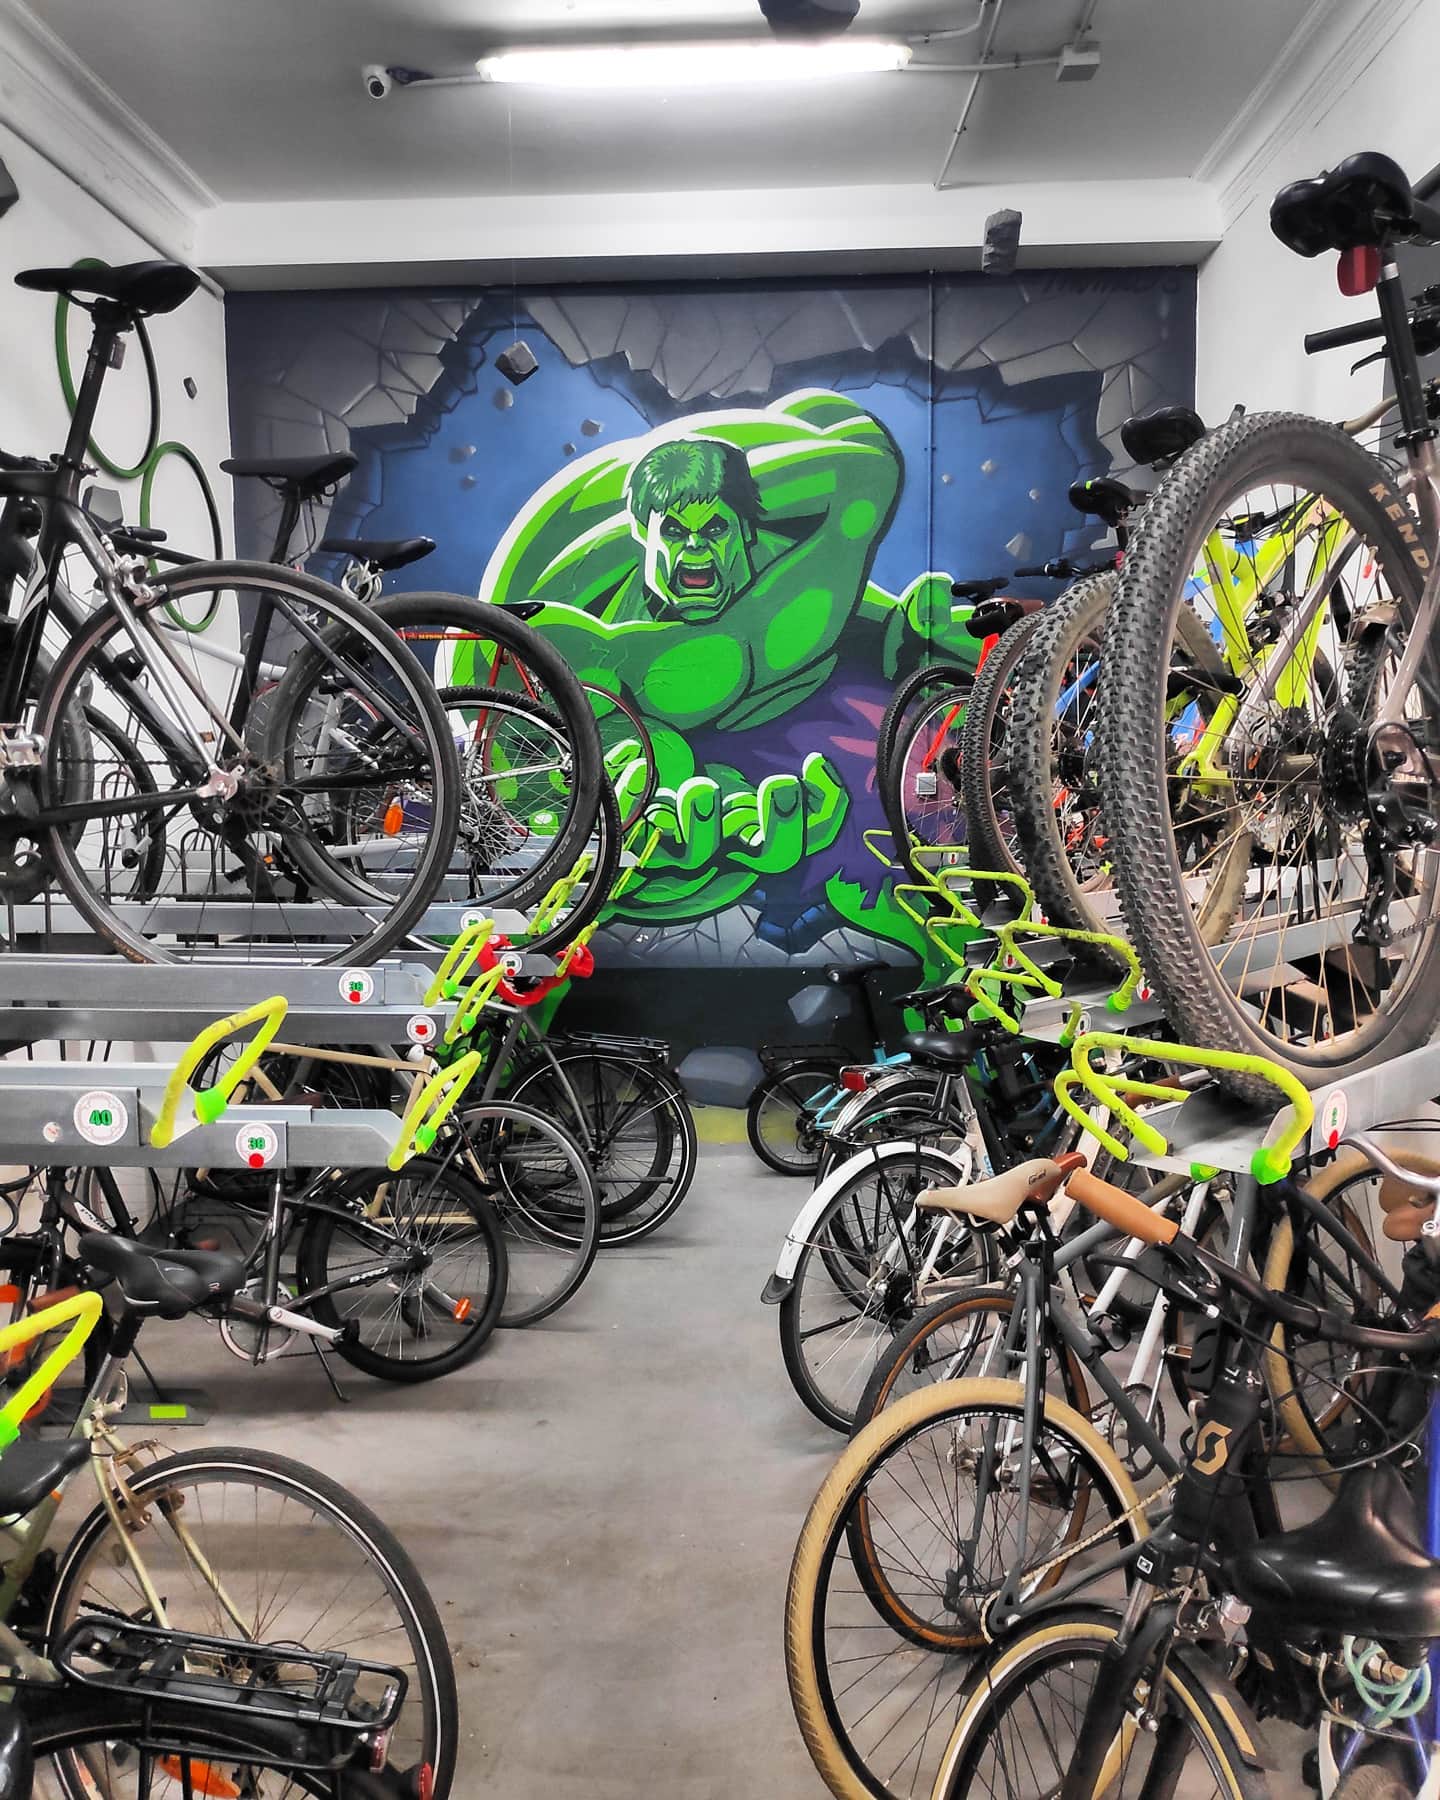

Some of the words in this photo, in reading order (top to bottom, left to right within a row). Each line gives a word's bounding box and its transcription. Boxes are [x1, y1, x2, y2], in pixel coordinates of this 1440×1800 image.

[1368, 482, 1431, 582] KEND
[88, 1109, 113, 1127] 40
[247, 1136, 266, 1150] 38
